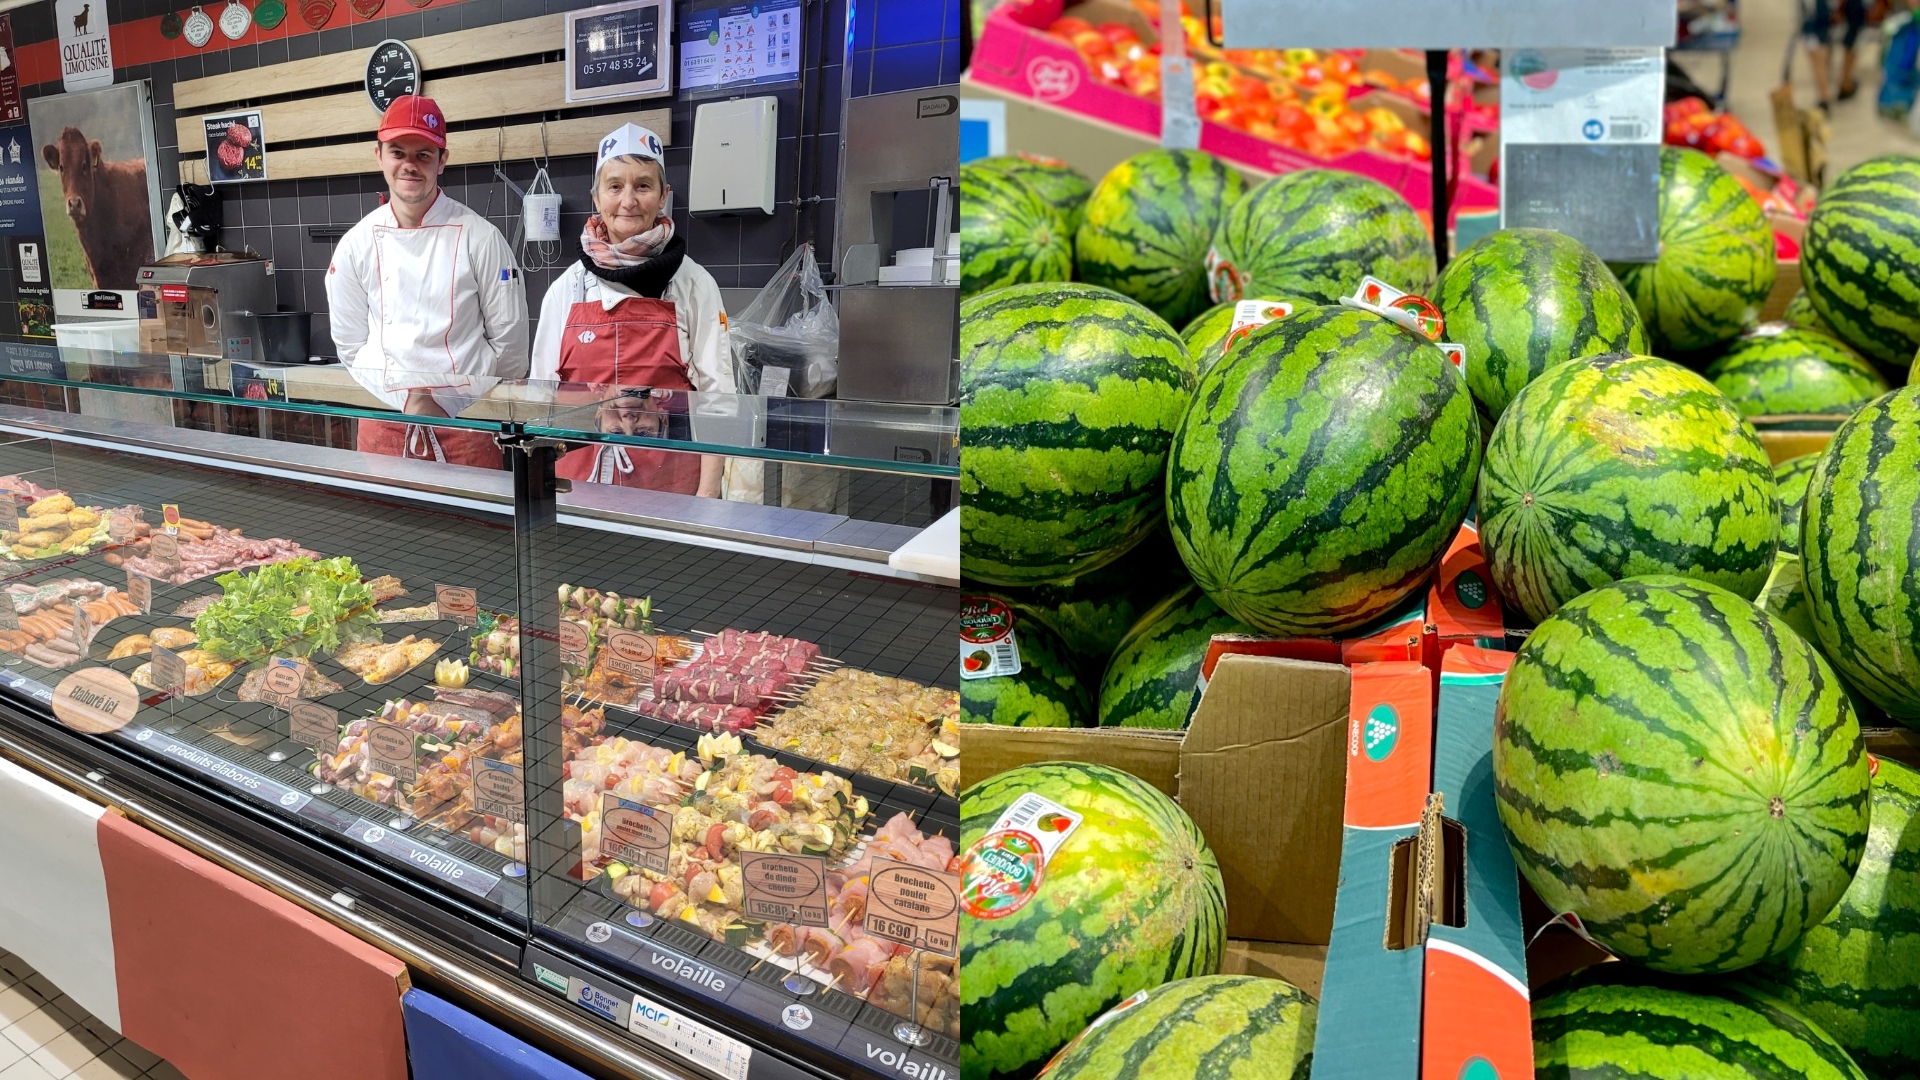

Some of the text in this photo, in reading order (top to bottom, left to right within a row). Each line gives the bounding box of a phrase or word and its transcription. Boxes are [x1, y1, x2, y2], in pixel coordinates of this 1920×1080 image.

[63, 35, 107, 62] QUALITÉ
[388, 50, 397, 58] 12
[65, 56, 109, 75] LIMOUSINE
[376, 66, 386, 74] 10
[404, 61, 411, 69] 2
[583, 56, 647, 74] 05 57 48 35 24
[207, 120, 235, 130] Steak haché
[245, 157, 256, 170] 14
[962, 603, 988, 616] Red
[963, 615, 997, 625] BOUQUET
[620, 639, 644, 649] Brochette
[69, 686, 120, 714] Elaboré ici
[165, 744, 260, 789] produits élaborés
[622, 818, 652, 833] Brochette
[409, 849, 464, 878] volaille
[762, 862, 798, 873] Brochette
[984, 853, 1022, 878] BOUQUET
[776, 874, 797, 883] dinde
[894, 873, 935, 890] Brochette
[768, 883, 795, 892] chorizo
[900, 888, 927, 900] poulet
[894, 898, 930, 913] catalane
[873, 919, 911, 939] 16 €90
[930, 936, 948, 948] Le kg
[651, 952, 726, 992] volaille
[594, 992, 618, 1008] Bonnet
[594, 999, 610, 1011] Névé
[636, 1002, 658, 1022] MCI
[866, 1043, 960, 1080] volaill
